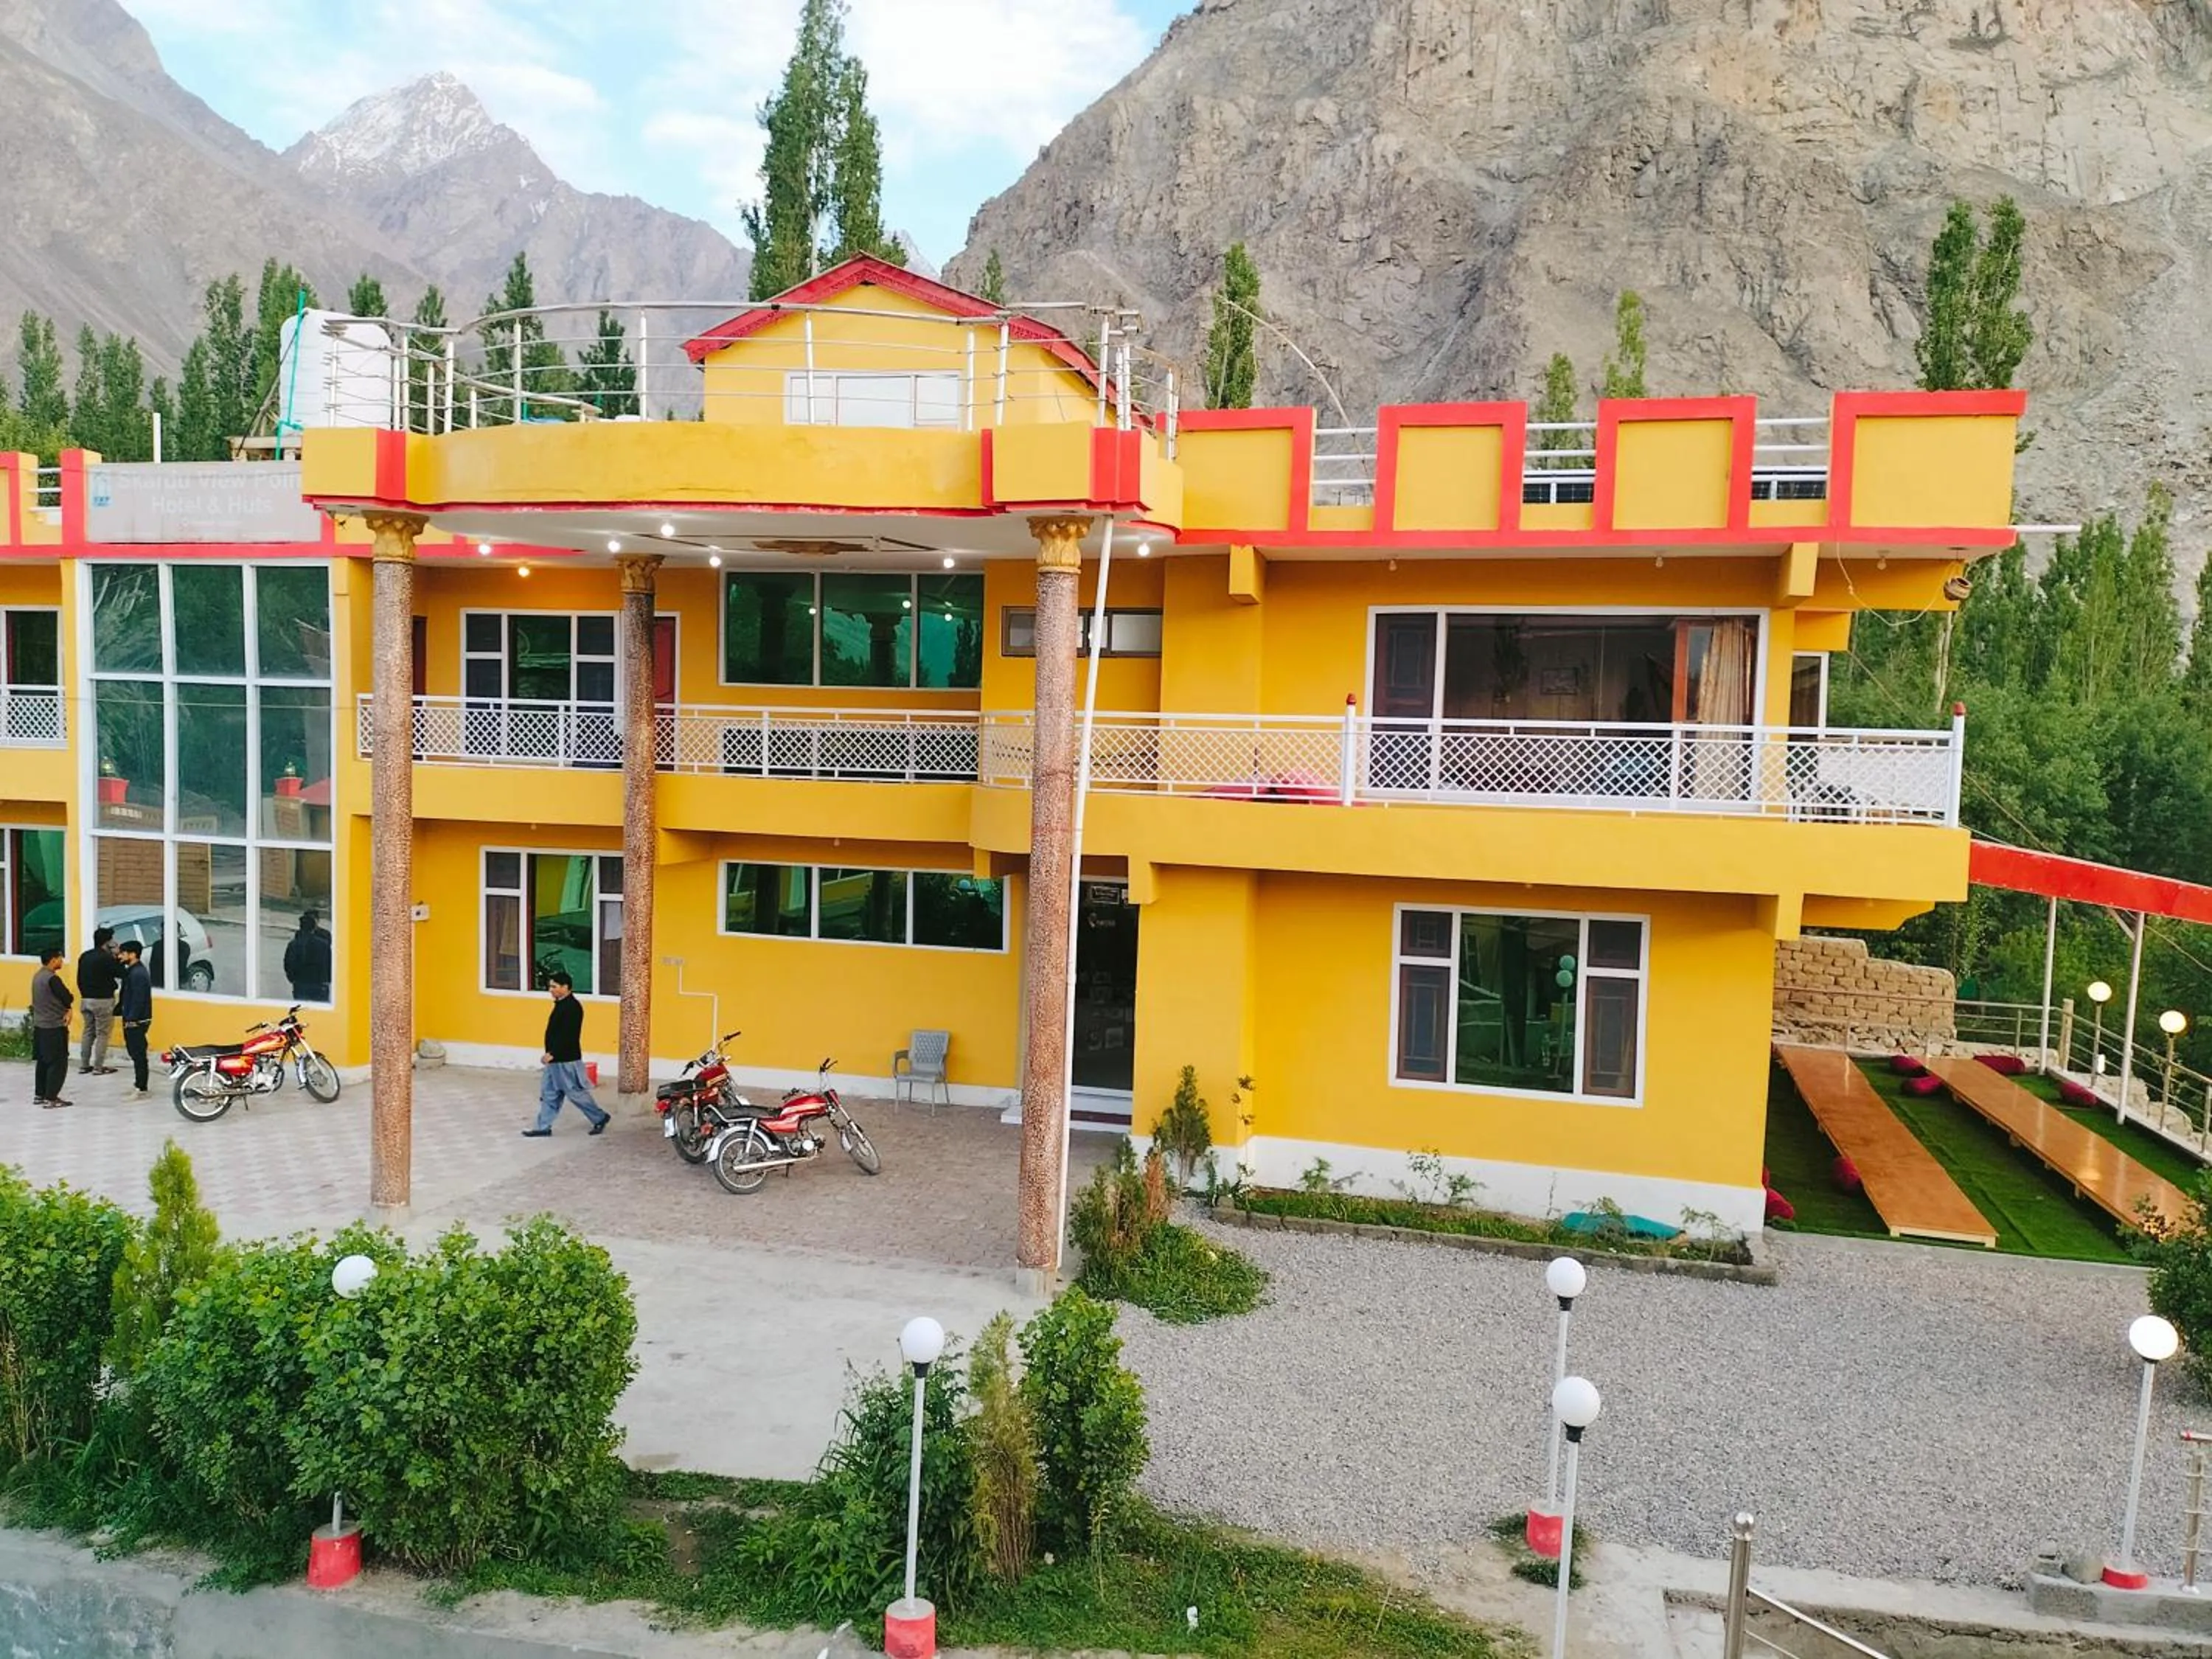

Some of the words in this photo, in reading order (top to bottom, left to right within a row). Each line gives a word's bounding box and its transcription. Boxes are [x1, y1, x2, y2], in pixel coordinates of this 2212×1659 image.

[198, 470, 246, 488] View
[254, 470, 302, 488] Poin
[152, 495, 202, 514] Hotel
[206, 495, 222, 514] &
[228, 495, 273, 514] Huts
